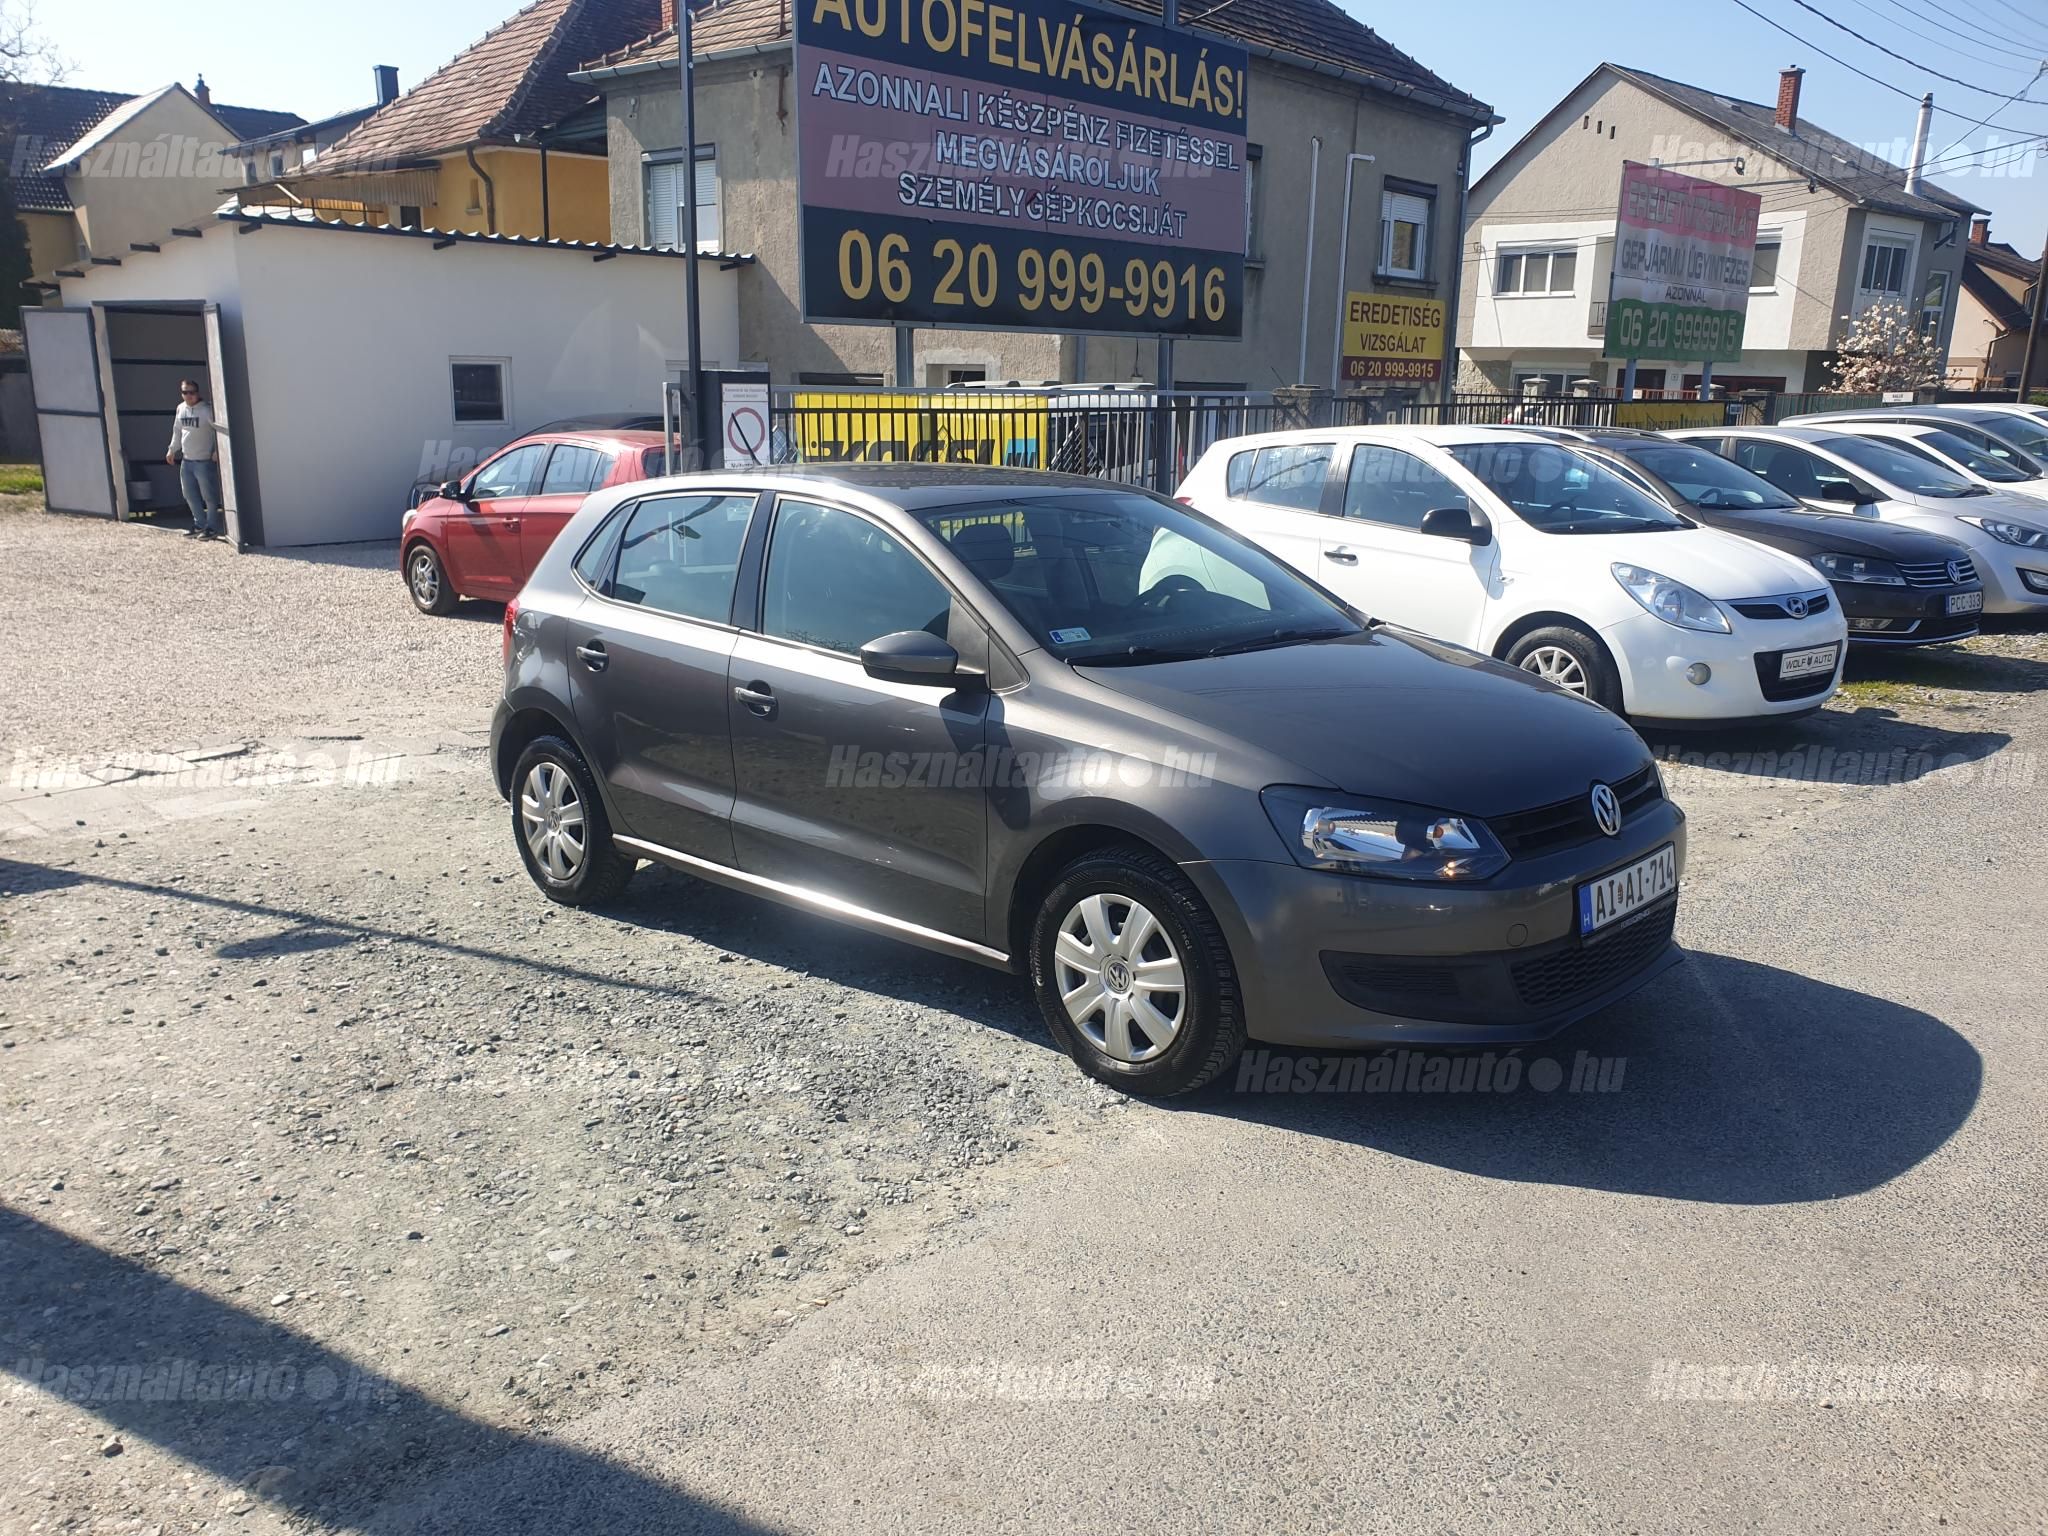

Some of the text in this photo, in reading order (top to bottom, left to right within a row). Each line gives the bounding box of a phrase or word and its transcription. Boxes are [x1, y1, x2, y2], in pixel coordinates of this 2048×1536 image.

[812, 62, 1240, 171] AZONNALI KÉSZPÉNZ FIZETÉSSEL
[935, 130, 1160, 197] MEGVÁSÁROLJUK
[838, 228, 1226, 323] 06 20 999-9916
[1349, 301, 1441, 328] EREDETISÉG
[1620, 307, 1737, 351] 06 20 9999915
[1360, 332, 1426, 353] VIZSGÁLAT
[1350, 361, 1434, 378] 06 20 999-9915
[1785, 653, 1833, 670] WOLF AUTO
[1596, 879, 1617, 923] AI
